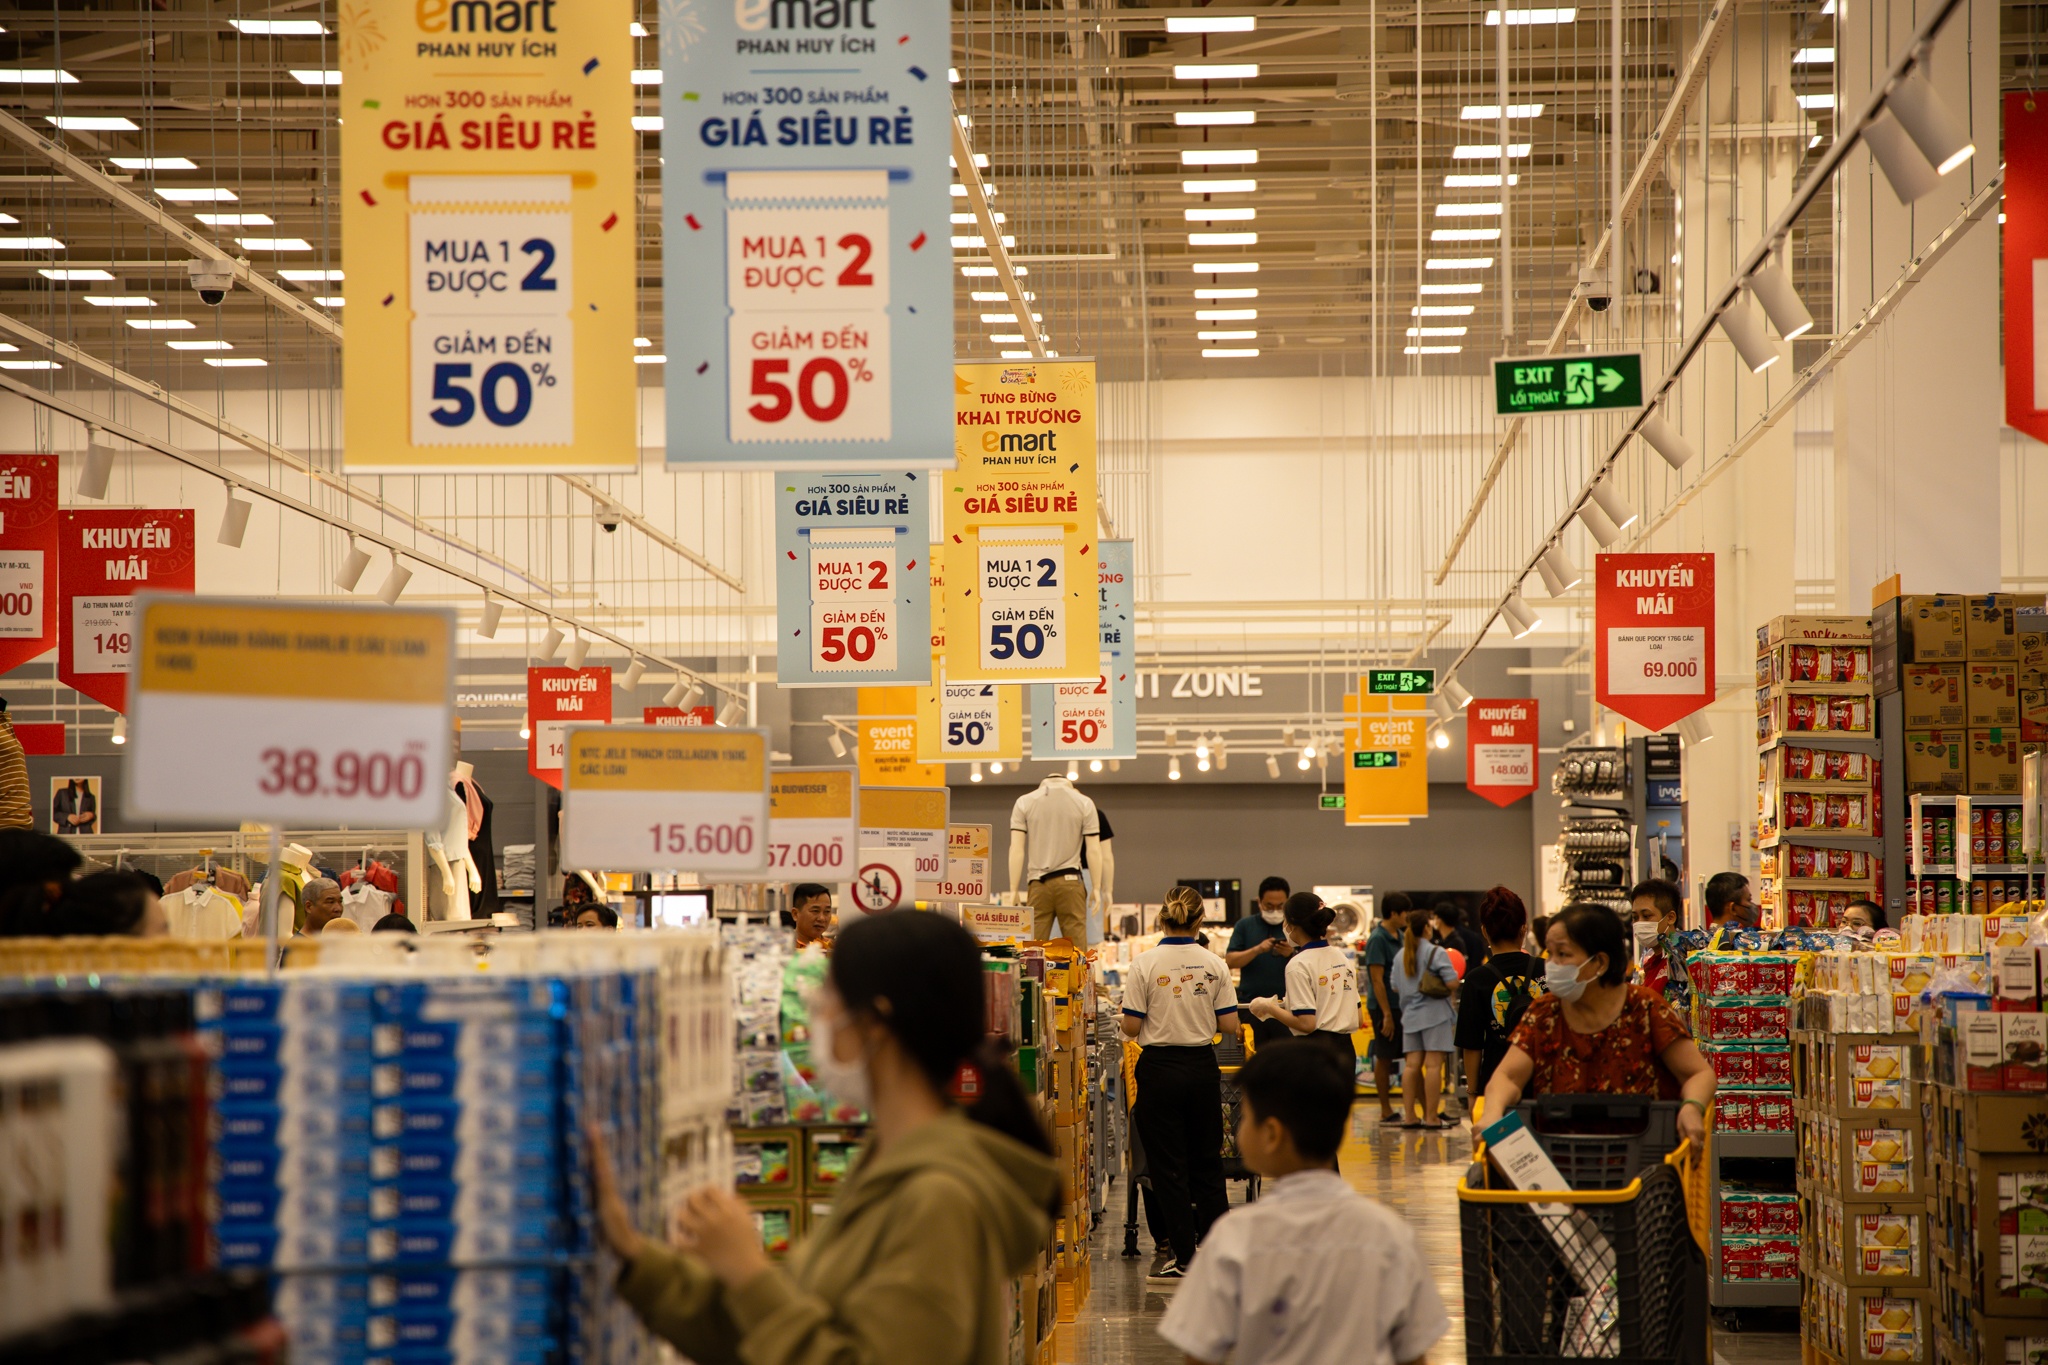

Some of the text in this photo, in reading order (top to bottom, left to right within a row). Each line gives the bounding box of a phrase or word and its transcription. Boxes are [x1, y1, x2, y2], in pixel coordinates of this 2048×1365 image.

[417, 38, 556, 57] PHAN HUY ÍCH
[736, 34, 876, 55] PHAN HUY ÍCH
[405, 94, 440, 108] HƠN
[446, 91, 485, 108] 300
[763, 87, 803, 105] 300
[381, 110, 597, 150] GIÁ SIÊU RẺ
[699, 106, 914, 147] GIÁ SIÊU RẺ
[425, 240, 509, 263] MUA 1
[743, 236, 826, 258] MUA 1
[427, 238, 557, 298] ĐƯỢC 2
[744, 233, 873, 294] ĐƯỢC 2
[433, 328, 552, 355] GIẢM ĐẾN
[752, 324, 868, 350] GIẢM ĐẾN
[1513, 366, 1555, 385] EXIT
[430, 361, 556, 427] 50%
[748, 357, 873, 423] 50%
[980, 390, 1057, 404] TƯNG BỪNG
[1510, 388, 1560, 406] LỐI THOÁT
[957, 408, 1082, 425] KHAI TRƯƠNG
[981, 430, 1057, 453] emart
[983, 454, 1056, 465] PHAN HUY ÍCH
[807, 486, 827, 494] HƠN
[828, 484, 850, 494] 300
[852, 484, 870, 493] SẢN
[976, 483, 995, 492] HƠN
[997, 482, 1019, 491] 300
[1021, 482, 1038, 491] SẢN
[795, 493, 909, 516] GIÁ SIÊU RẺ
[964, 491, 1078, 514] GIÁ SIÊU RẺ
[82, 520, 171, 549] KHUYẾN
[105, 554, 148, 581] MÃI
[818, 562, 863, 575] MUA 1
[987, 560, 1032, 573] MUA 1
[988, 558, 1057, 591] ĐƯỢC 2
[1616, 562, 1694, 587] KHUYẾN
[819, 561, 888, 594] ĐƯỢC 2
[82, 601, 123, 609] ÁO THUN NAM
[1636, 592, 1674, 615] MÃI
[823, 608, 885, 624] GIẢM ĐẾN
[992, 606, 1054, 621] GIẢM ĐẾN
[93, 632, 132, 654] 149
[820, 626, 888, 662] 50%
[989, 623, 1057, 660] 50%
[1104, 628, 1121, 644] RẺ
[1618, 634, 1634, 642] BÁNH
[1682, 633, 1694, 641] CÁC
[1643, 661, 1698, 677] 69.000
[541, 673, 597, 692] KHUYẾN
[1171, 665, 1263, 698] ZONE
[1377, 673, 1396, 682] EXIT
[946, 687, 976, 699] ĐƯỢC
[1060, 675, 1107, 698] ĐƯỢC 2
[456, 693, 528, 708] EQUIPME
[556, 697, 583, 712] MÃI
[655, 712, 702, 726] KHUYẾN
[949, 709, 992, 720] GIẢM ĐẾN
[1062, 708, 1105, 718] GIẢM ĐẾN
[1479, 704, 1527, 720] KHUYẾN
[869, 724, 914, 739] event
[947, 721, 994, 746] 50%
[1061, 719, 1108, 744] 50%
[1369, 719, 1415, 733] event
[1491, 722, 1515, 737] MÃI
[873, 738, 911, 751] zone
[1373, 733, 1412, 746] zone
[259, 746, 425, 800] 38.900
[1489, 764, 1529, 775] 148.000
[781, 784, 828, 795] BUDWEISER
[649, 823, 754, 855] 15.600
[956, 831, 971, 845] RẺ
[936, 882, 983, 896] 19.900
[872, 898, 883, 907] 18
[975, 912, 1020, 924] GIÁ SIÊU RẺ
[1986, 918, 1998, 931] LU
[1892, 959, 1904, 973] LU
[1896, 996, 1909, 1011] LU
[1858, 1045, 1870, 1057] LU
[1859, 1082, 1871, 1095] LU
[1860, 1129, 1873, 1140] LU
[1864, 1166, 1876, 1179] LU
